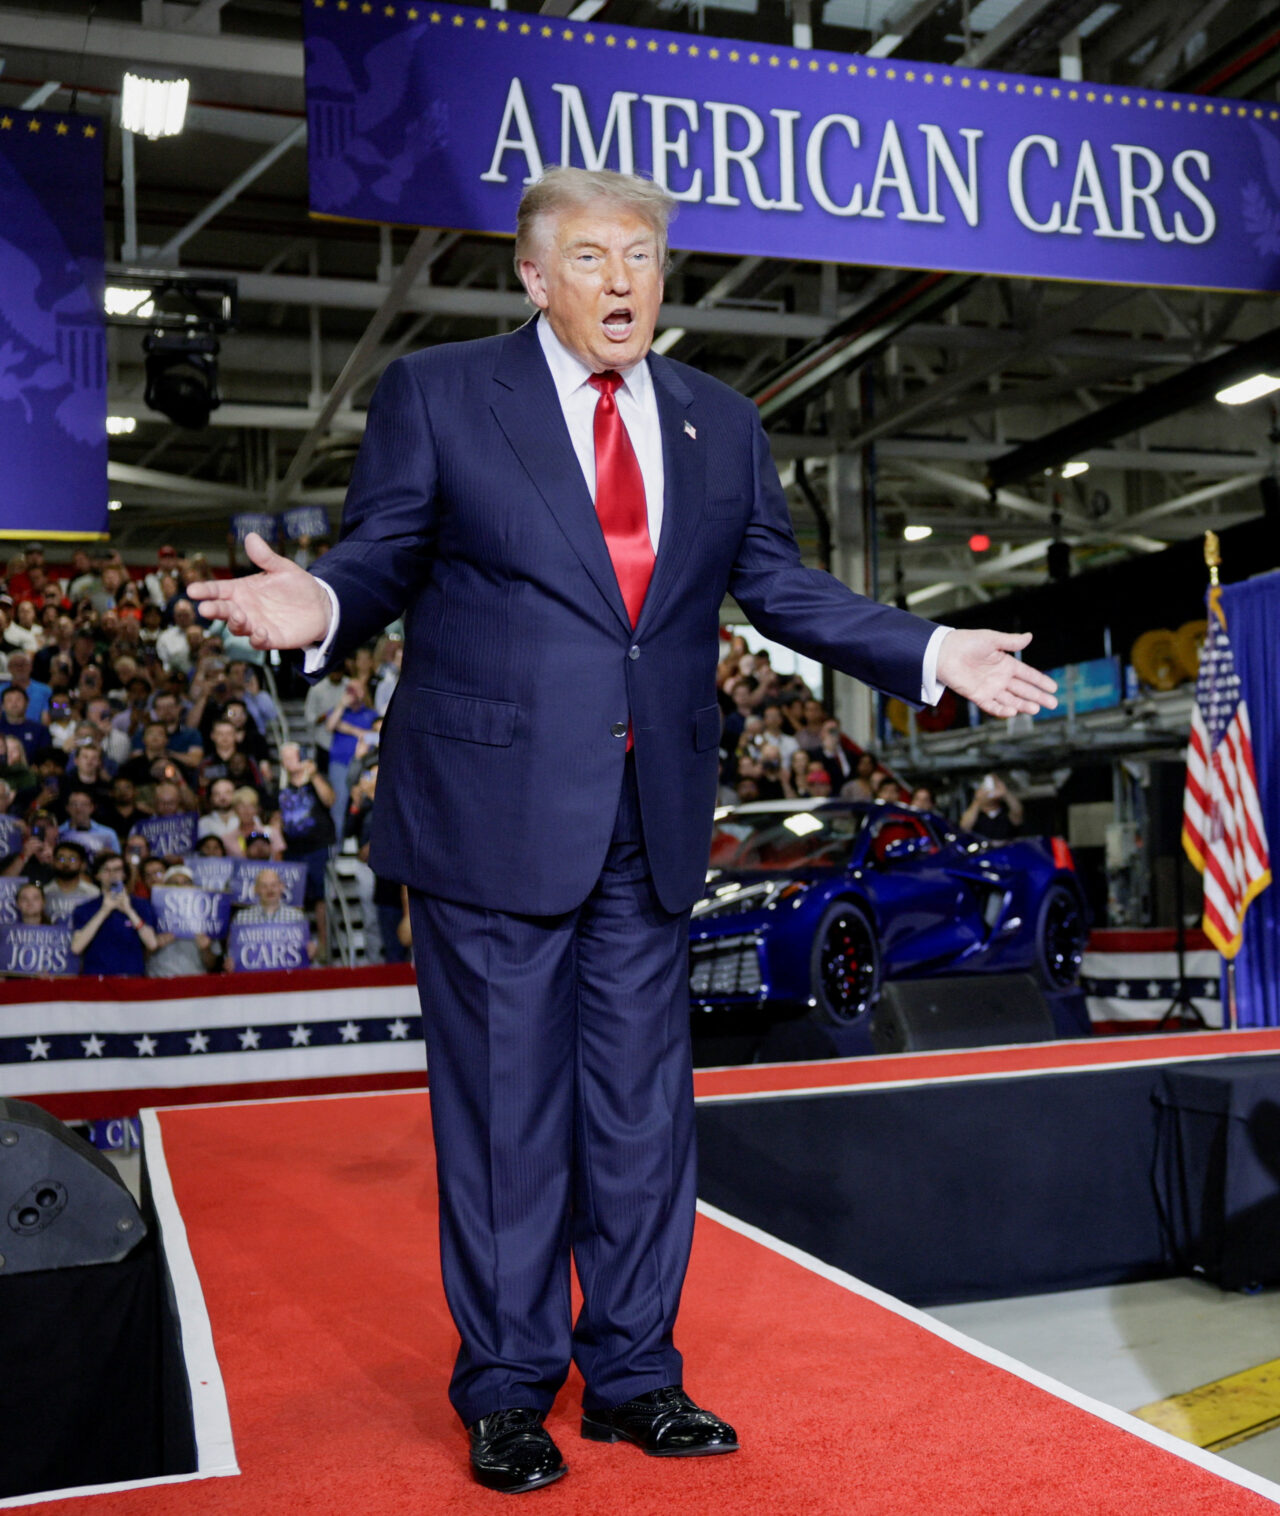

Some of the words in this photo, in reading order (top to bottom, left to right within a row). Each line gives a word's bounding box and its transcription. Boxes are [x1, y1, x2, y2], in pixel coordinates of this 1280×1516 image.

[480, 77, 984, 227] AMERICAN
[1008, 134, 1217, 244] CARS
[6, 928, 72, 946] AMERICAN
[238, 926, 303, 944] AMERICAN
[7, 944, 68, 972] JOBS
[241, 941, 302, 970] CARS
